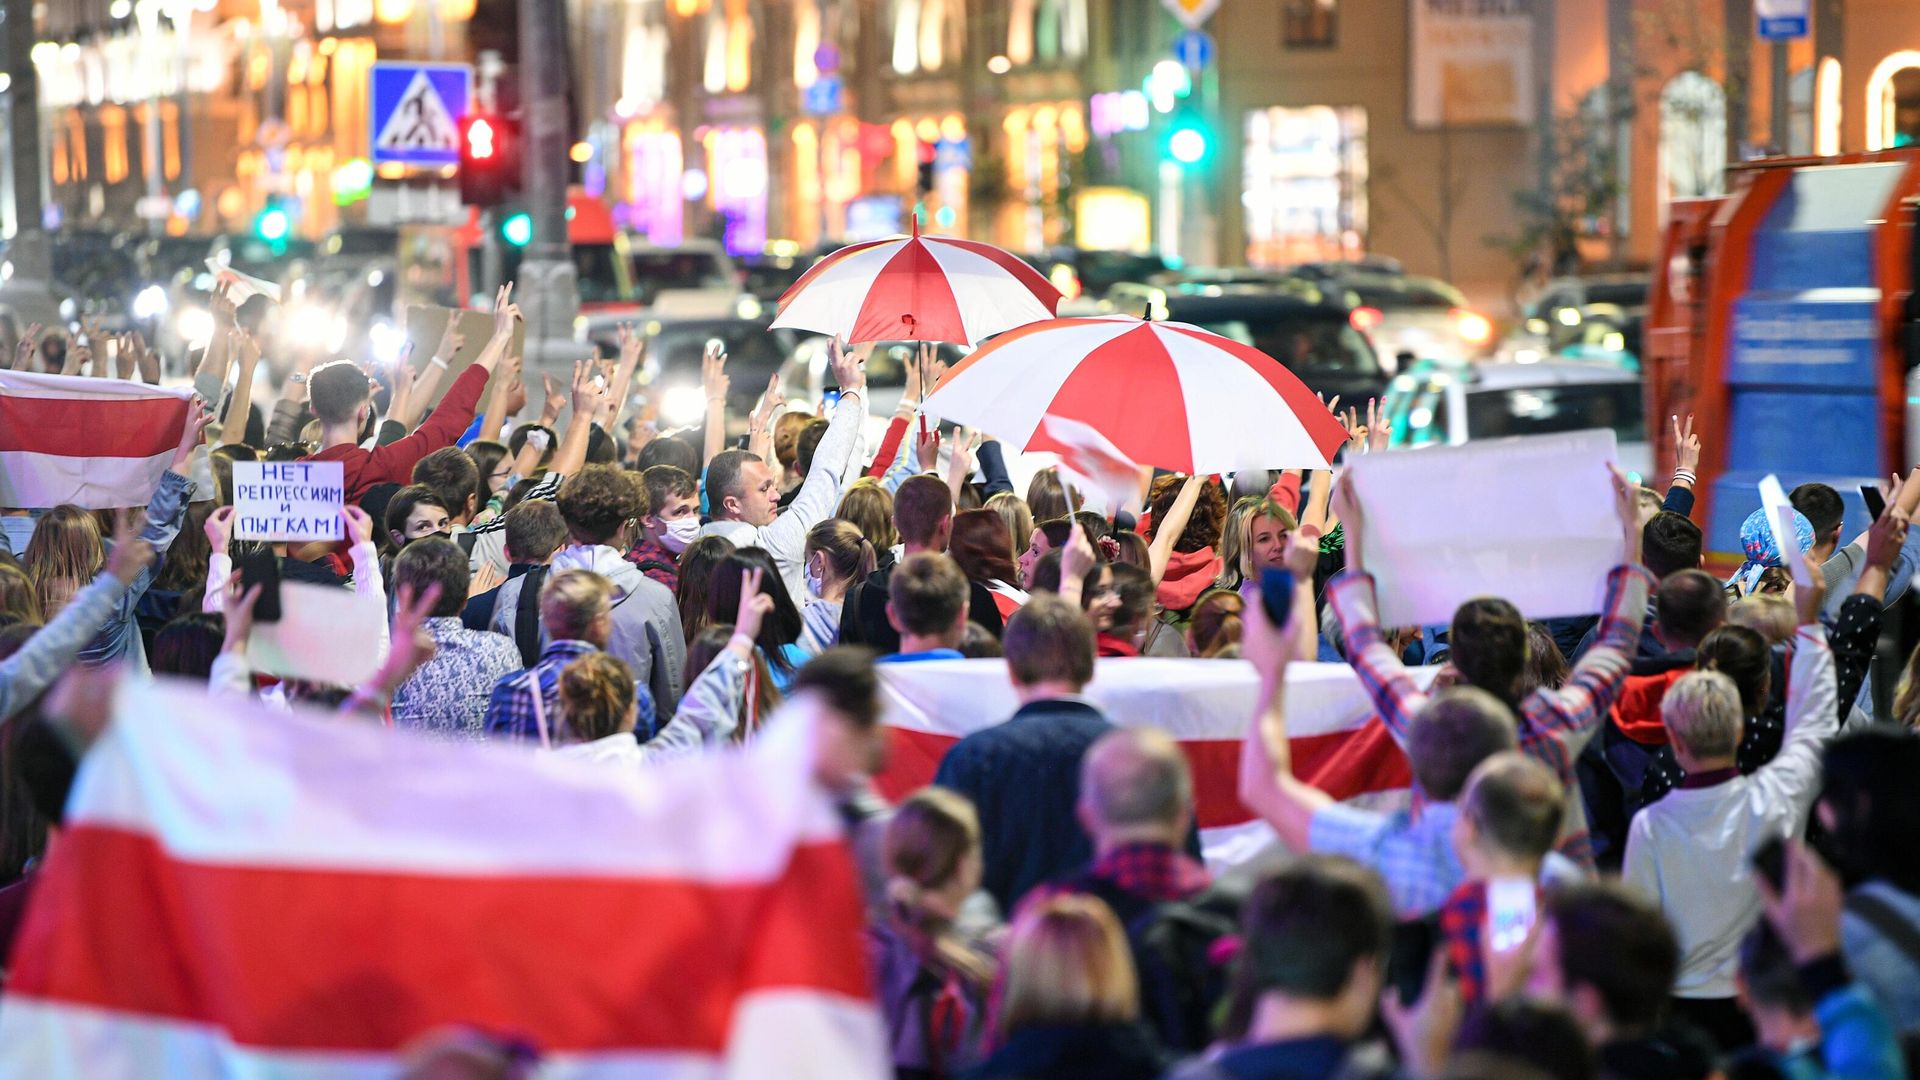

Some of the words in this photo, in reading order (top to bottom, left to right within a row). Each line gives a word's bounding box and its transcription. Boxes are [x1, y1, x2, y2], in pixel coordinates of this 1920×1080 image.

[262, 463, 313, 482] НЕТ
[238, 485, 341, 504] РЕПРЕССИЯМ
[241, 514, 339, 535] ПЫТКАМ!
